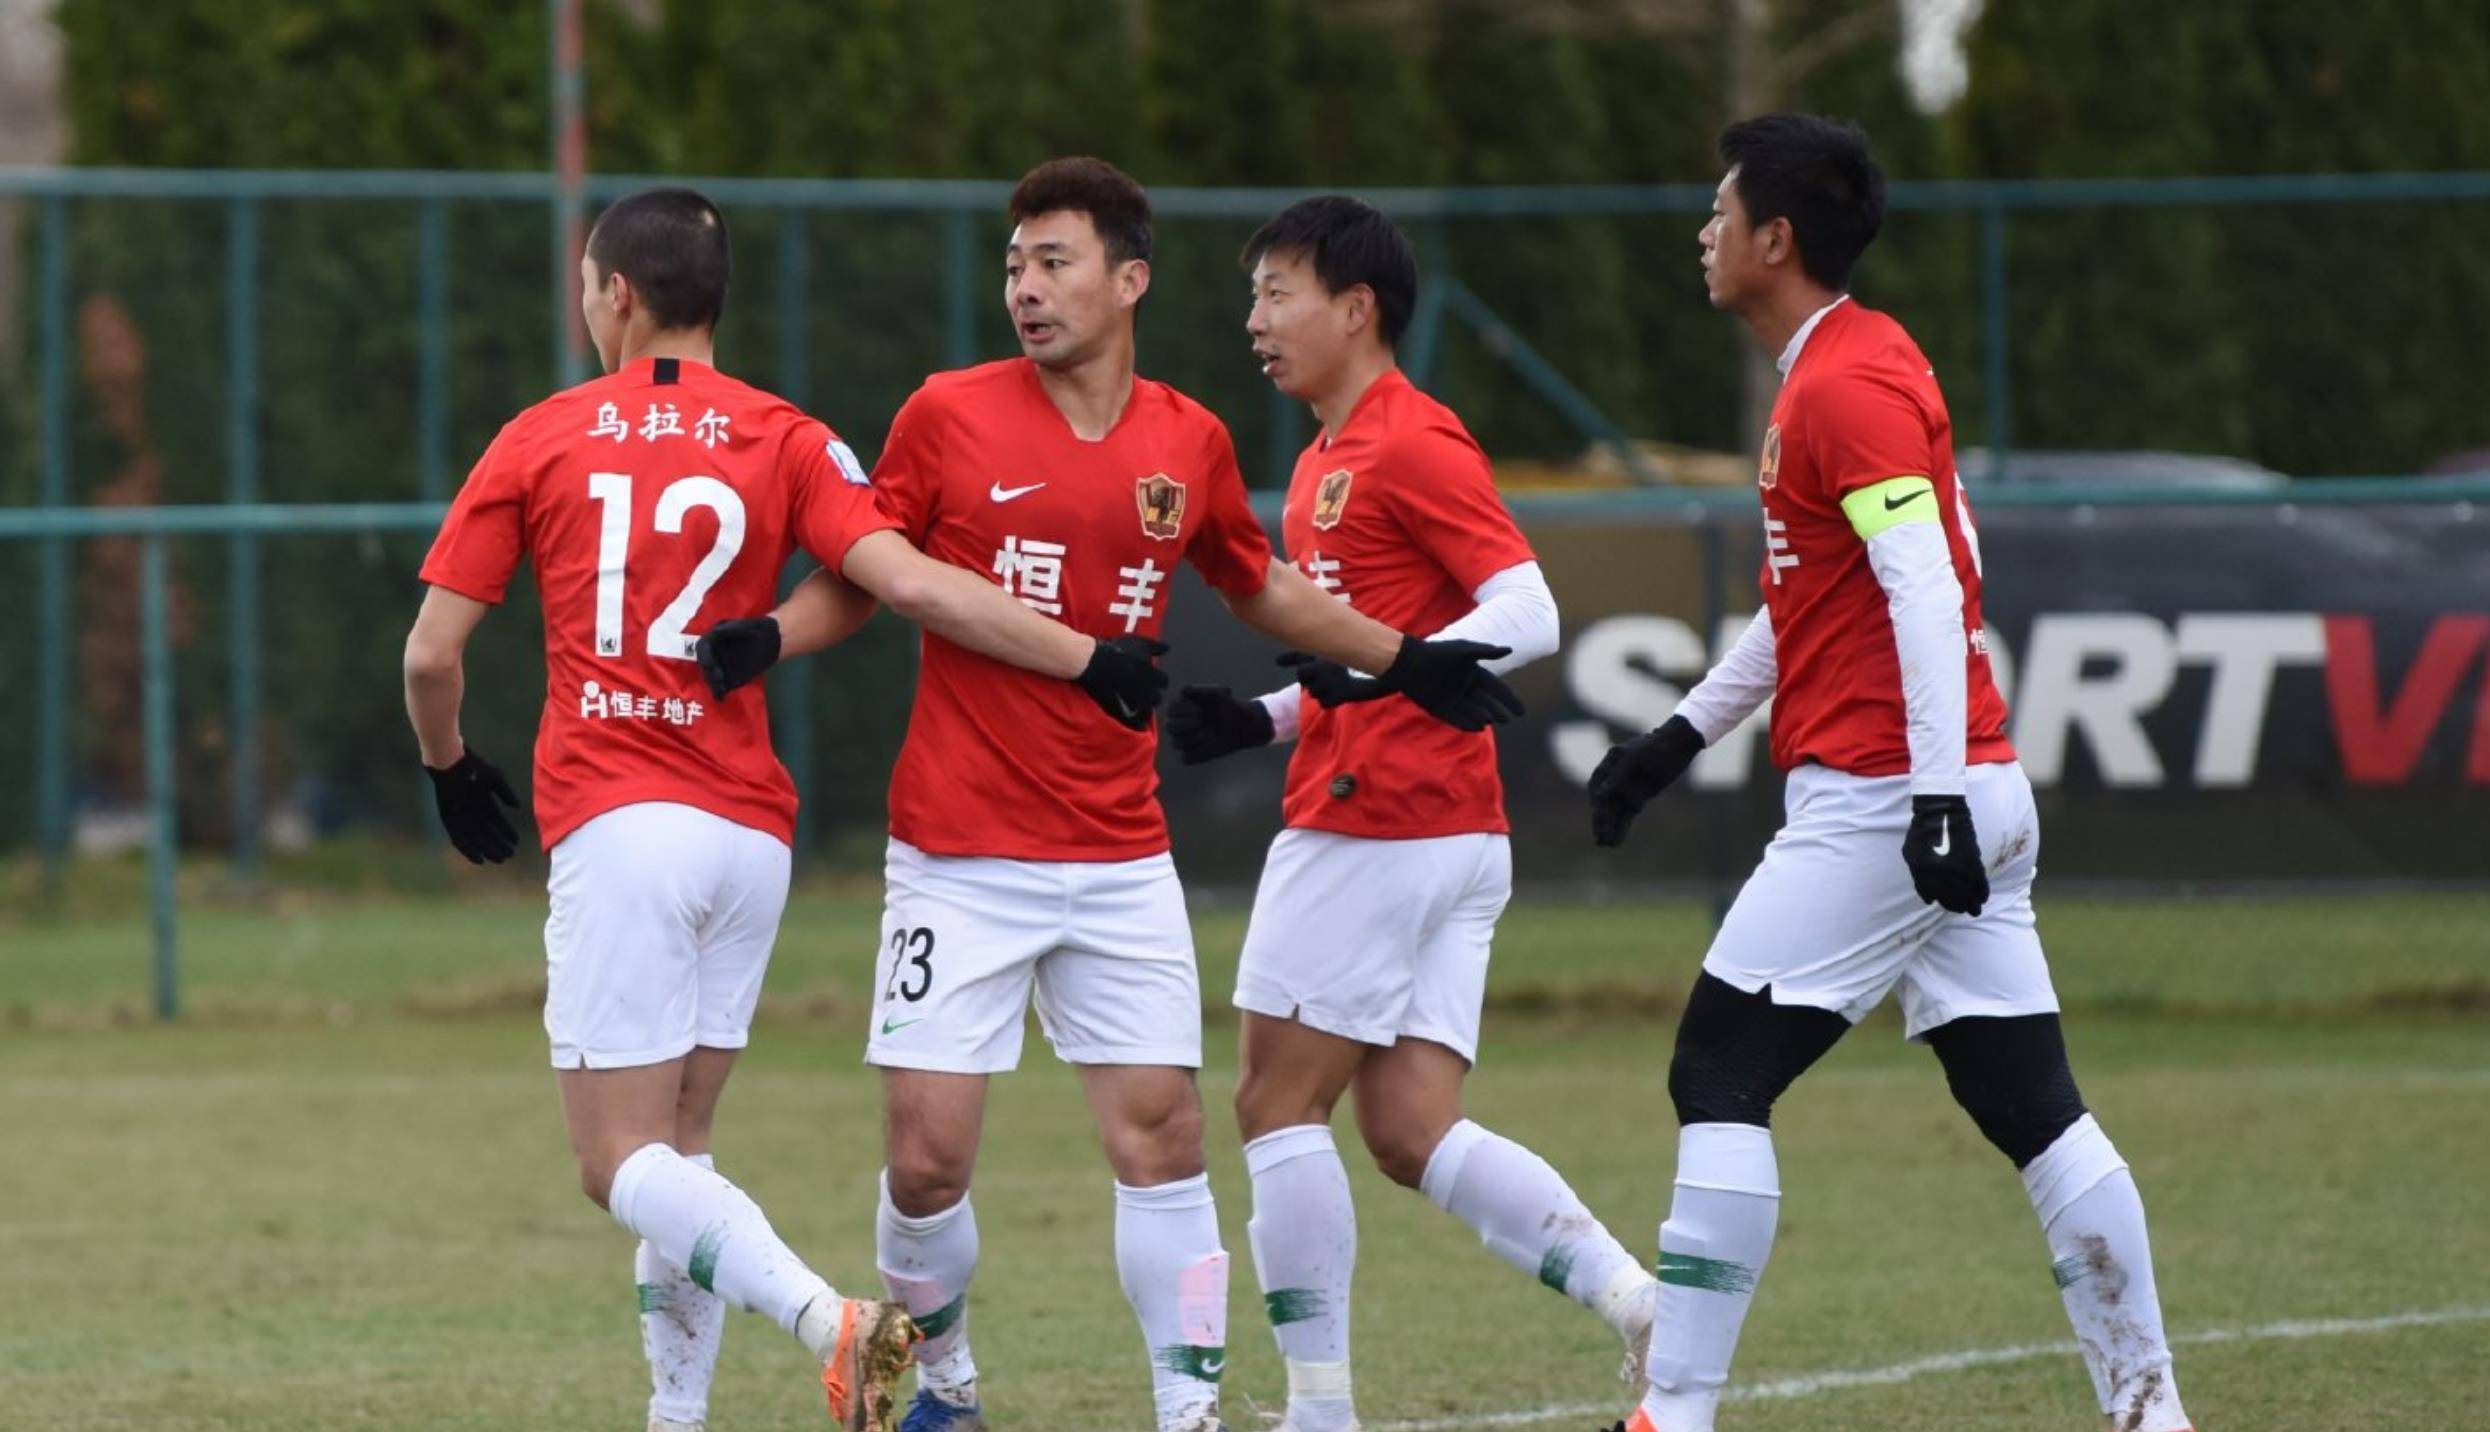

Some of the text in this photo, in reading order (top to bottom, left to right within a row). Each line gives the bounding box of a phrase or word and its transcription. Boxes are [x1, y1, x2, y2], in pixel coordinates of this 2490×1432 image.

[587, 401, 732, 449] 乌拉尔
[588, 472, 747, 661] 12
[610, 689, 705, 726] 恒丰地产
[883, 926, 936, 1003] 23
